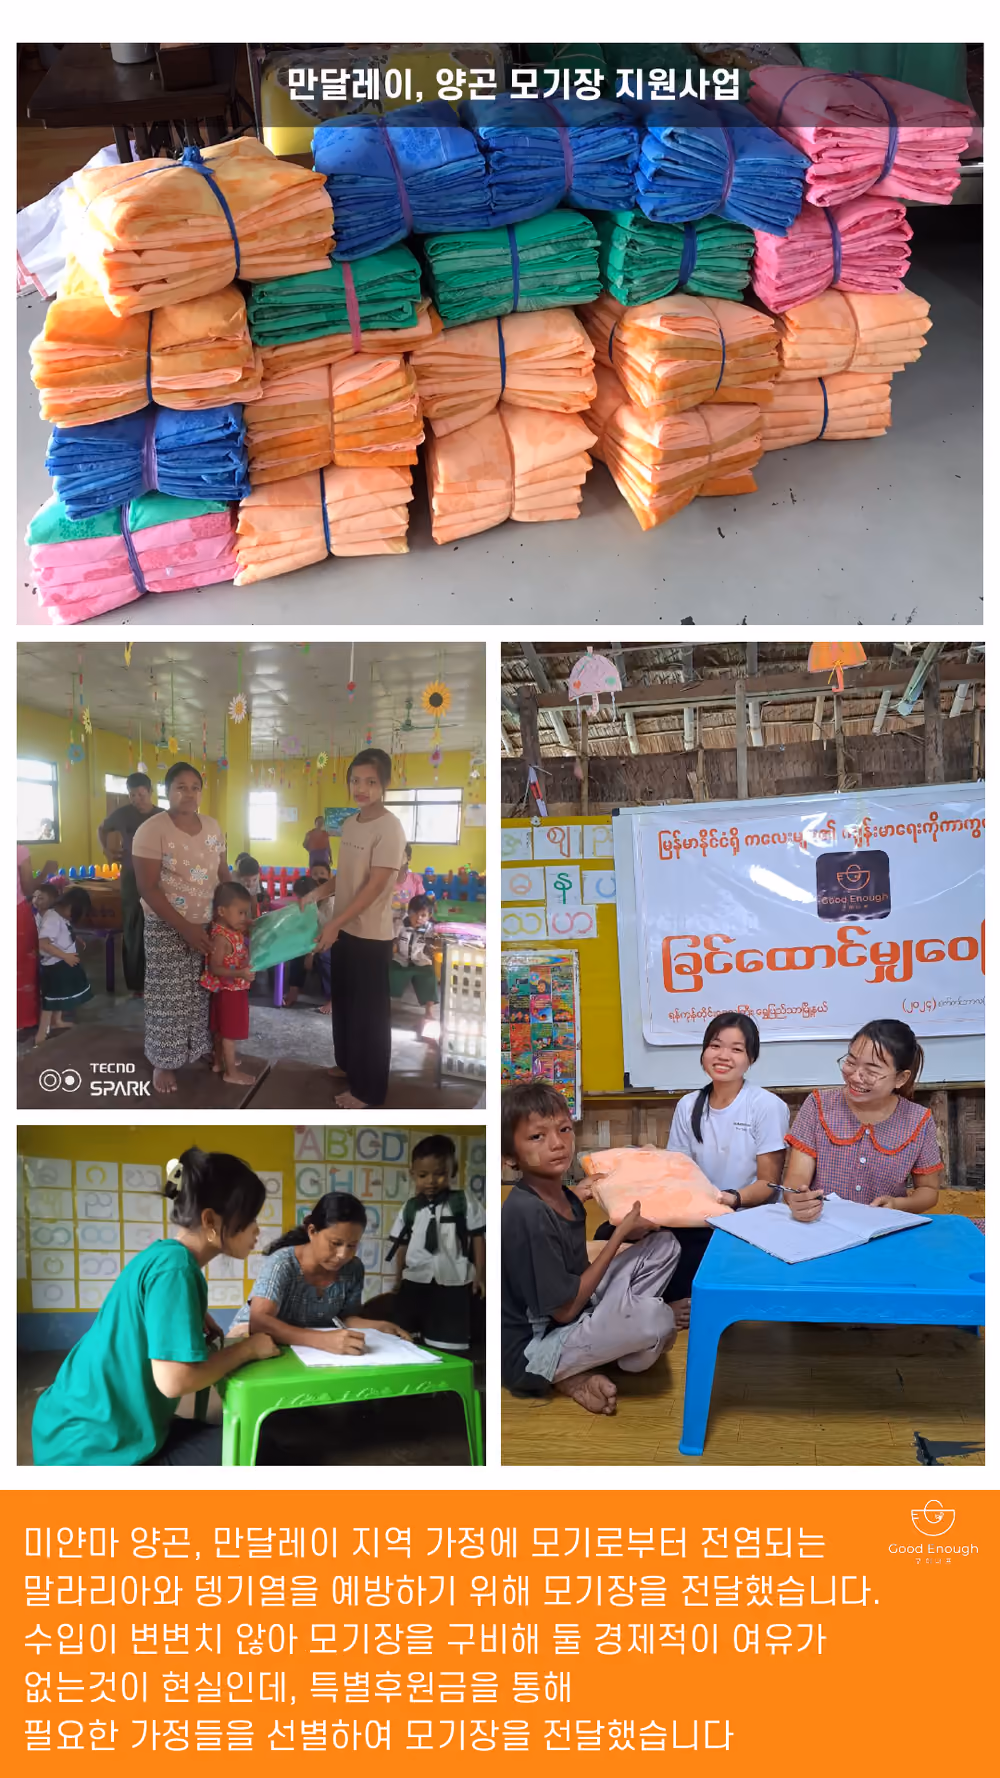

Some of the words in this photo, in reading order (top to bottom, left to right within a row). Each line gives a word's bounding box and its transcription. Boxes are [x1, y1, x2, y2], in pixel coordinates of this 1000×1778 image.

[661, 919, 985, 993] ခြင်ထောင်မျှဝေ
